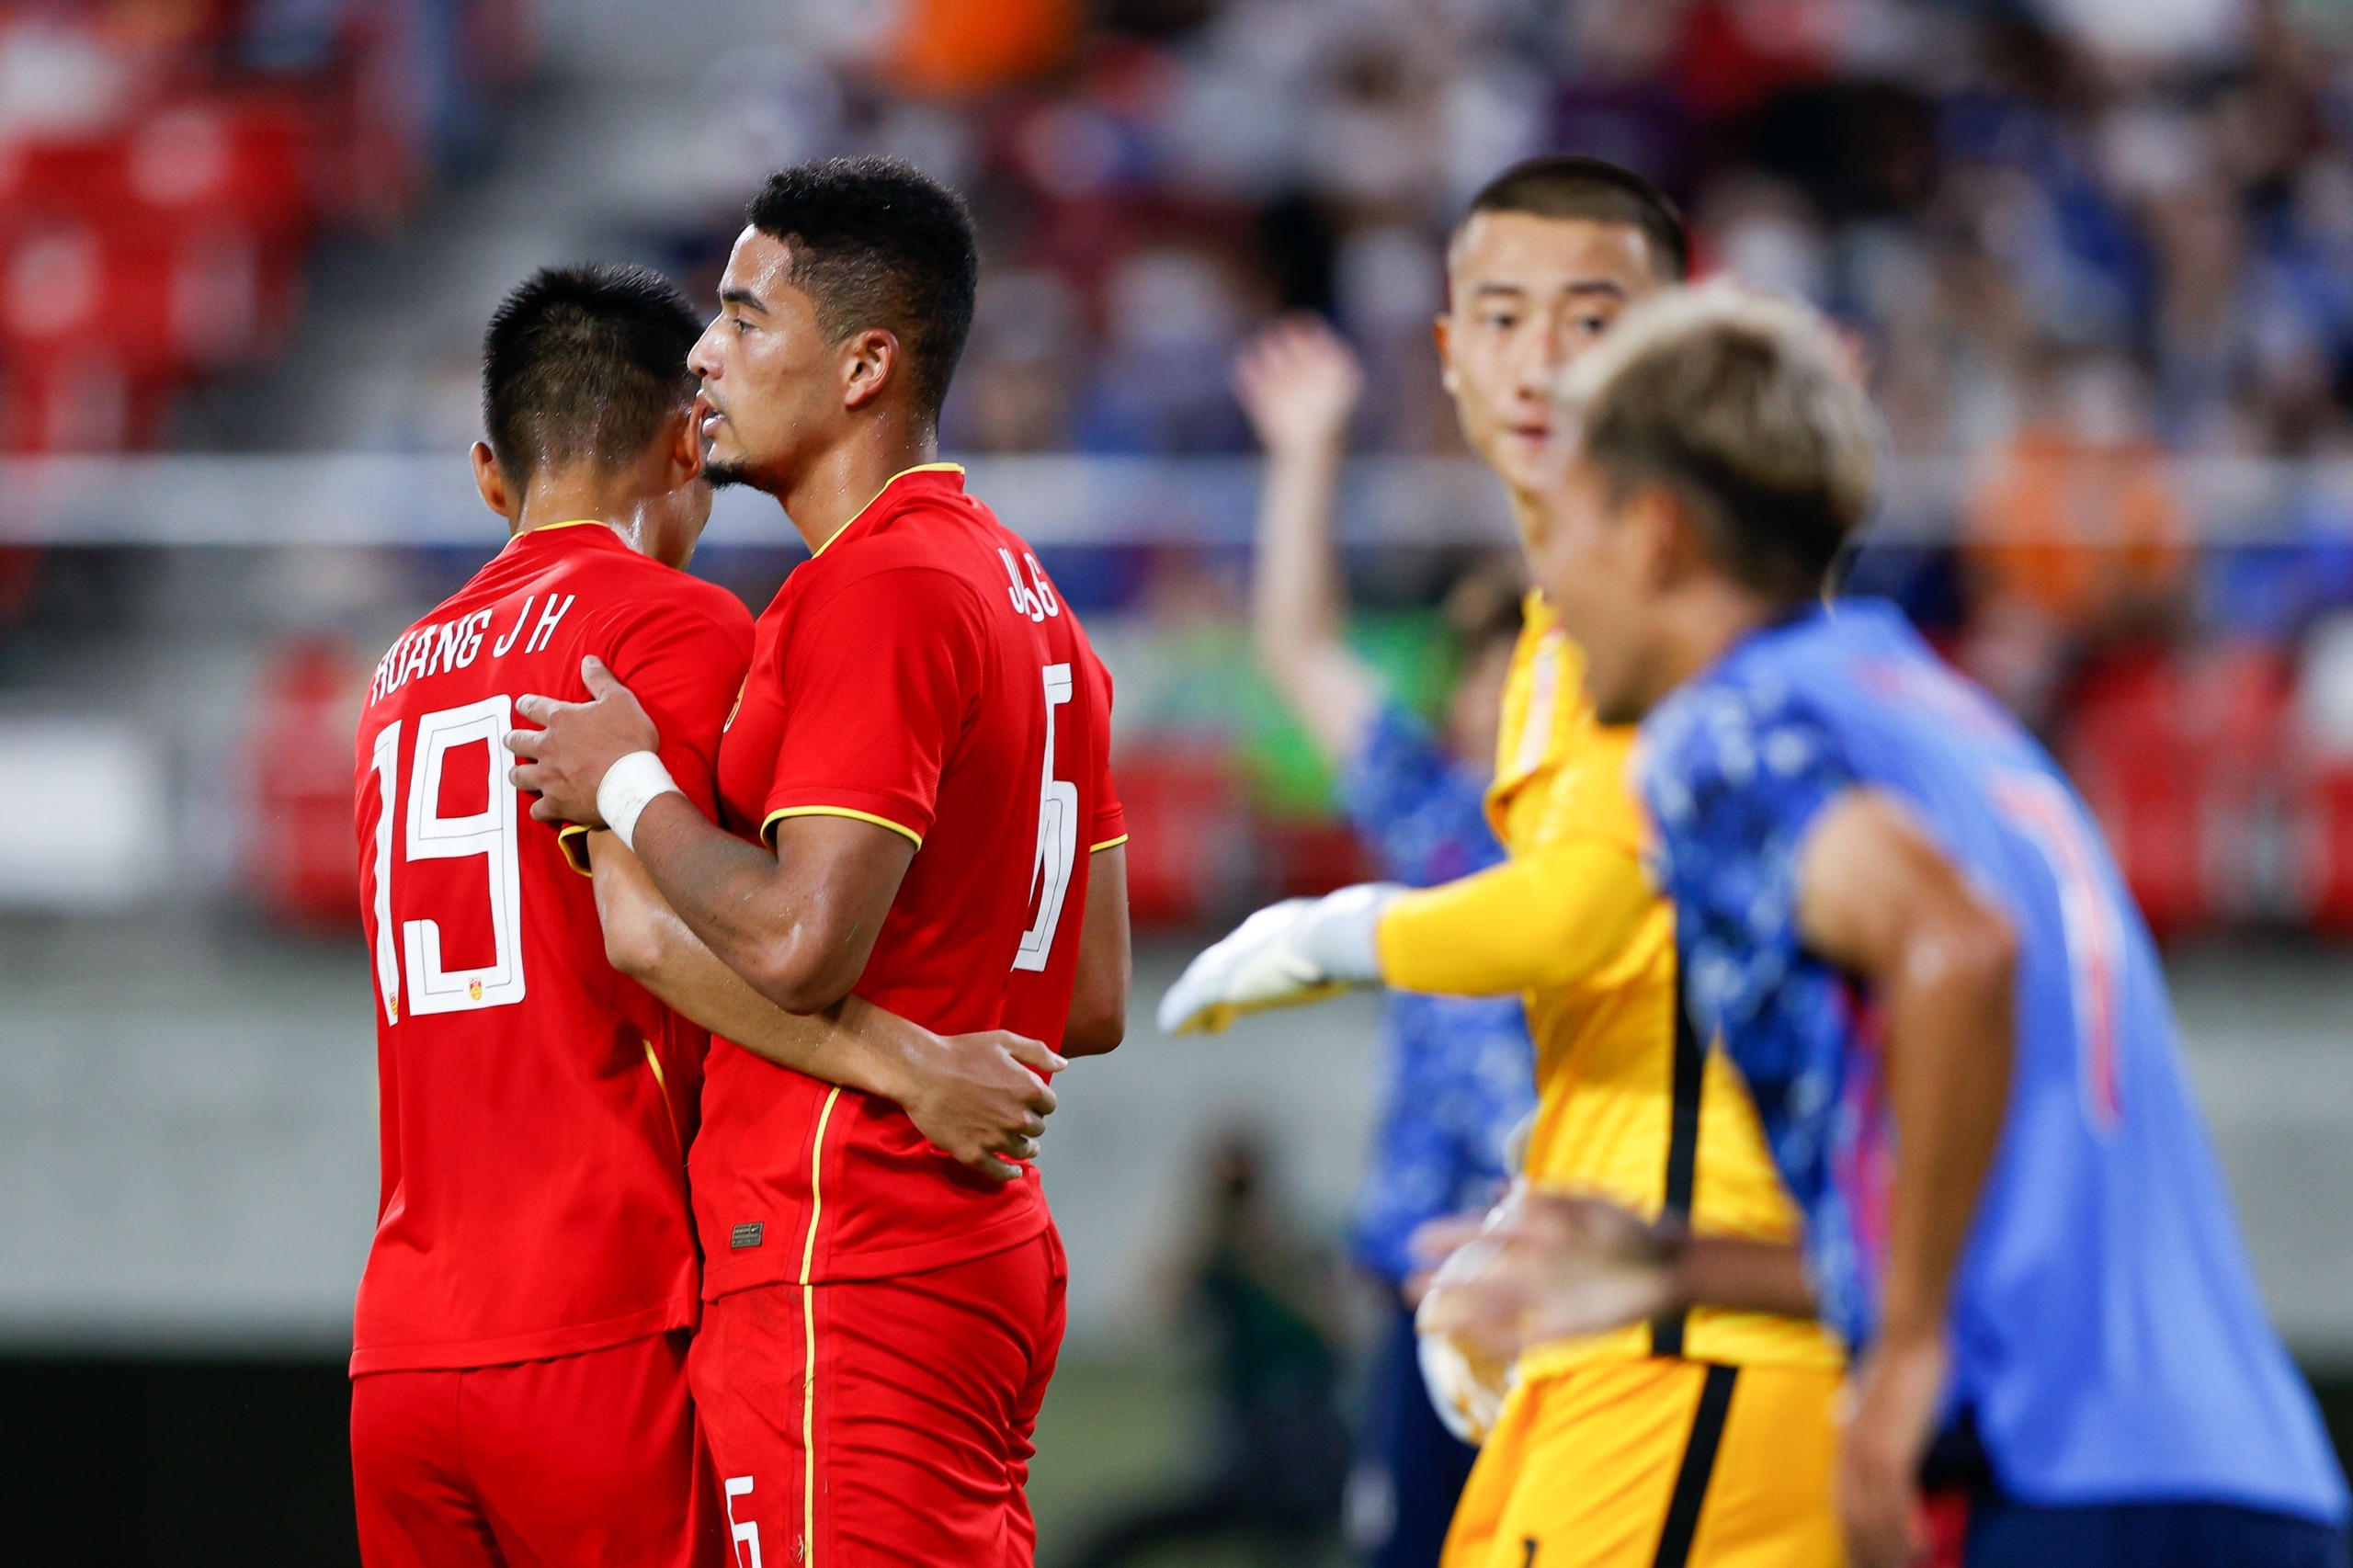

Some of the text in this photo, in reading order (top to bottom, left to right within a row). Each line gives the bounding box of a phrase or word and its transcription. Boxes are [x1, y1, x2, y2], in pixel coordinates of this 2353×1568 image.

[370, 593, 575, 708] HUANG J H
[369, 694, 527, 1027] 19
